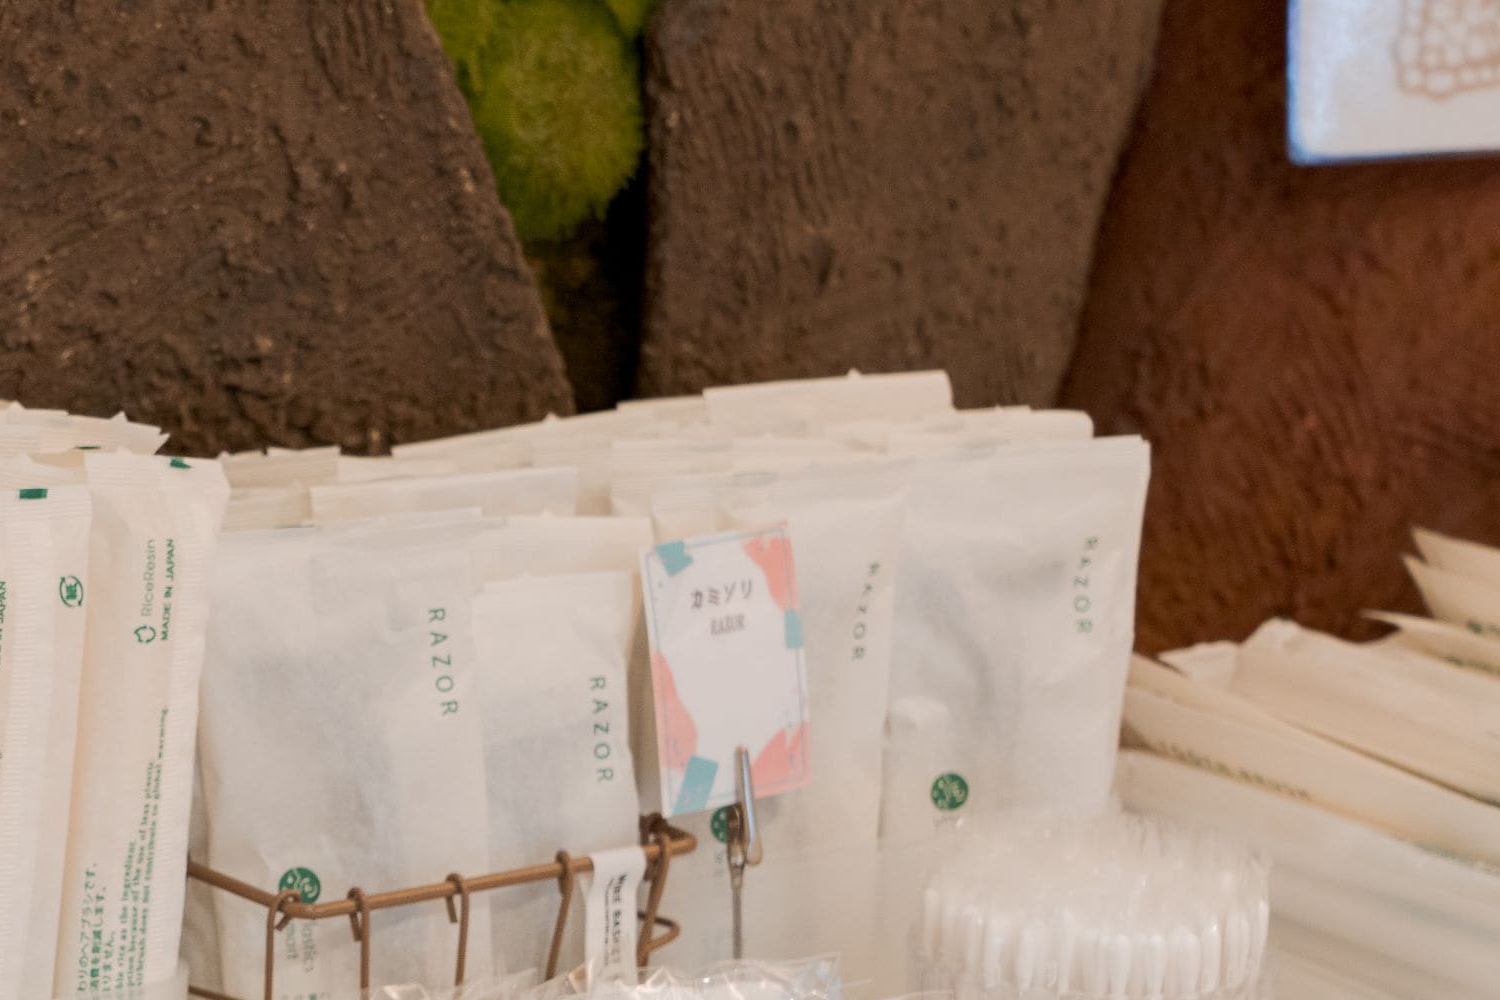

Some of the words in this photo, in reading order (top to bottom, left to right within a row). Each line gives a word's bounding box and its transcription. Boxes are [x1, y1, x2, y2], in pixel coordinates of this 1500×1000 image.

[165, 539, 176, 581] JAPAN
[163, 586, 174, 598] IN
[690, 579, 753, 611] カミソリ
[1073, 536, 1099, 634] RAZOR
[160, 604, 172, 641] MADE
[428, 608, 459, 715] RAZOR
[590, 675, 614, 782] RAZOR
